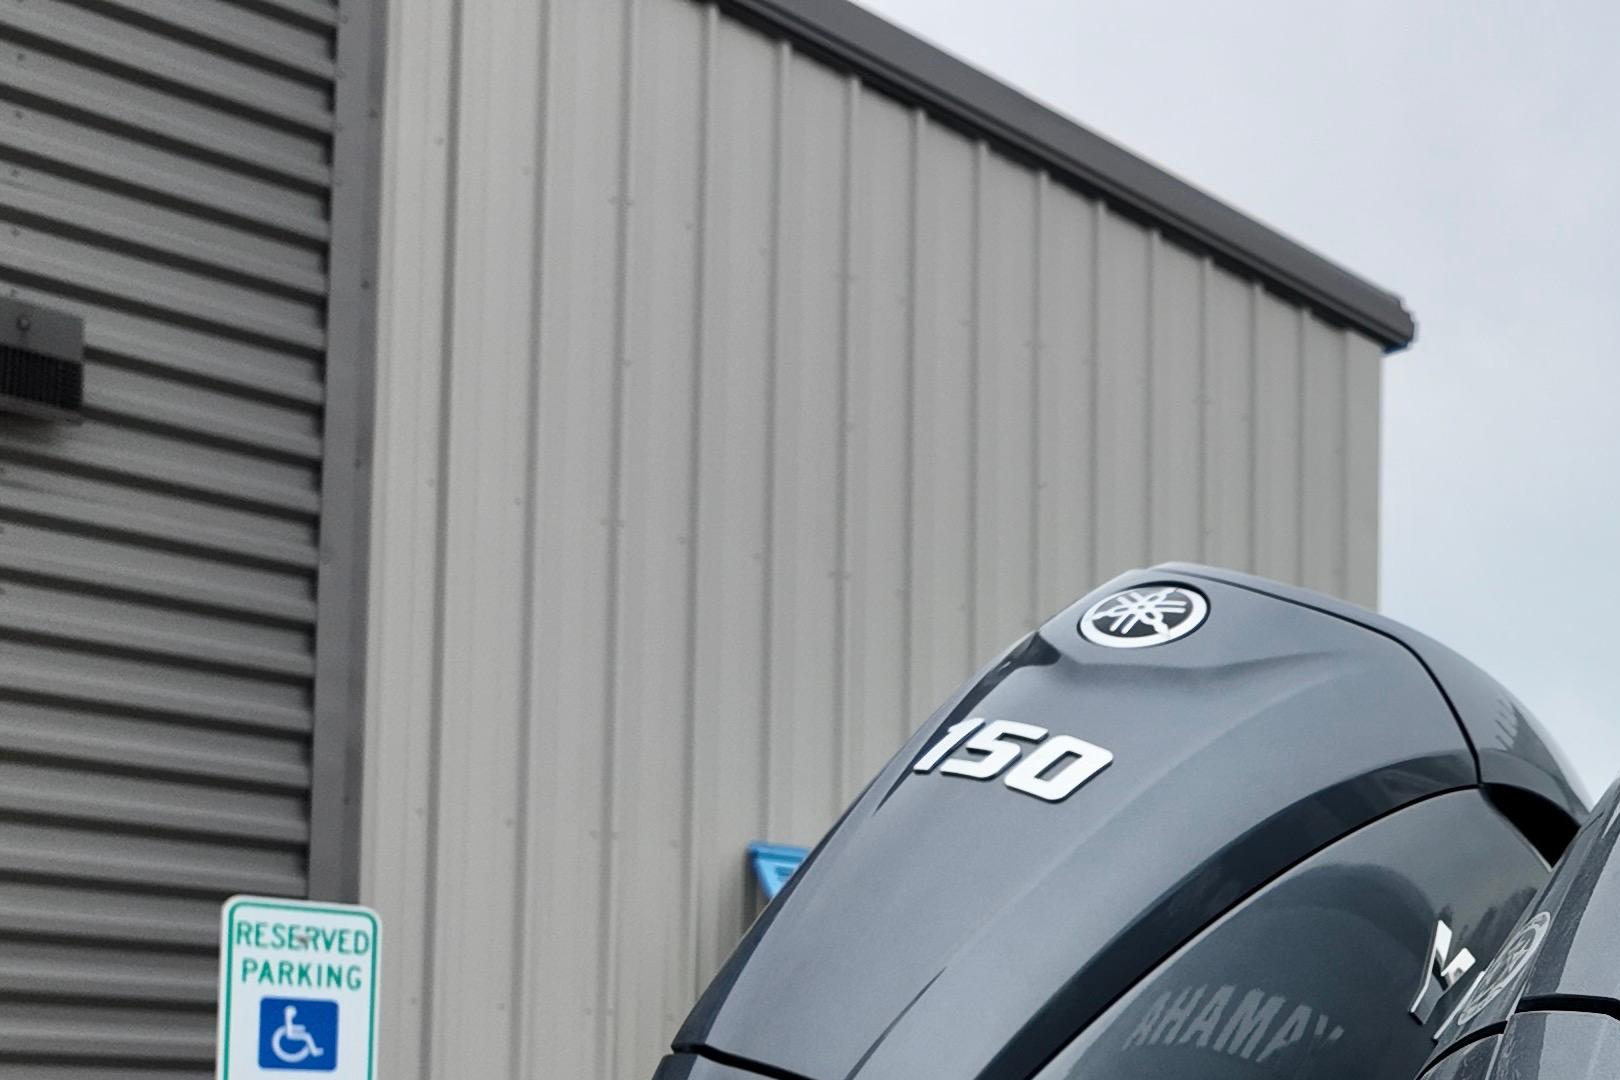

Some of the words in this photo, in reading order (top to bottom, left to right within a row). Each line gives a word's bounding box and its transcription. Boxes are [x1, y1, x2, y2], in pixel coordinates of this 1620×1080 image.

[913, 717, 1114, 803] 150
[237, 920, 369, 955] RESERVED
[242, 957, 362, 990] PARKING
